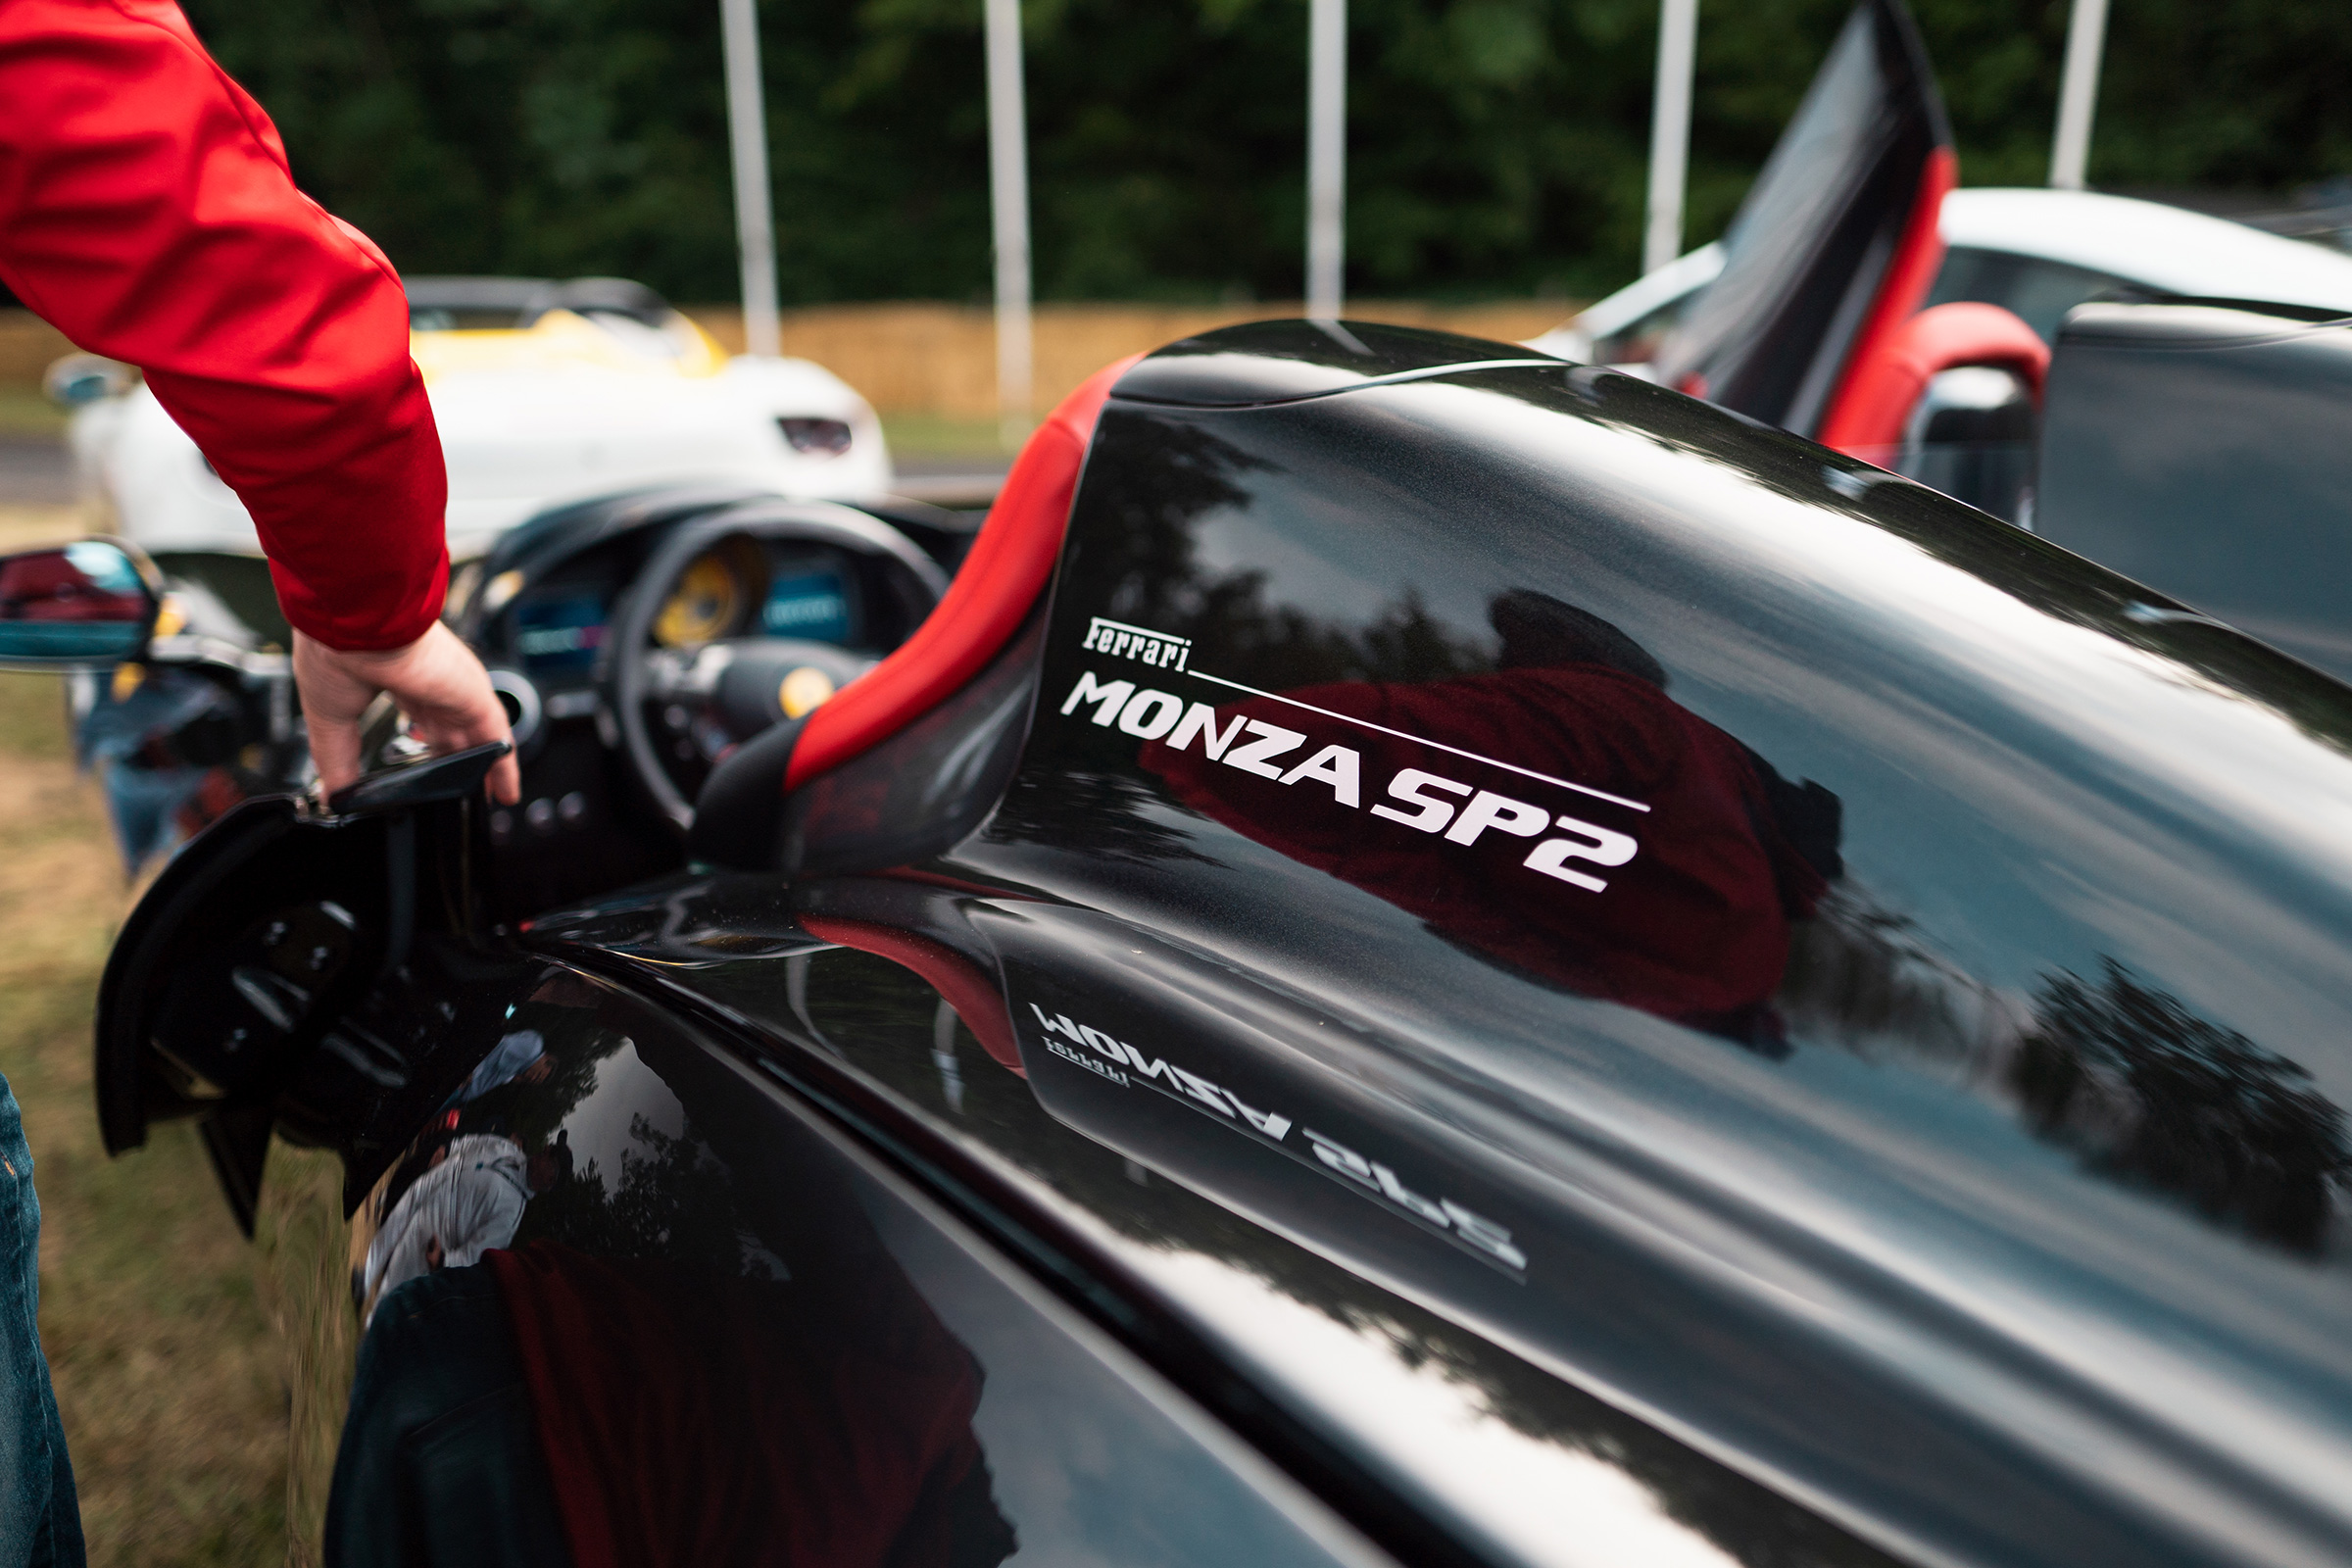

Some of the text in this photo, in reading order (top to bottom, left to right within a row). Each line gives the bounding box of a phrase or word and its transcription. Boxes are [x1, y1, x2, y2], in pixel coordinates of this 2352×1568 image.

[1082, 616, 1192, 672] Ferrari
[1060, 671, 1639, 893] MONZA SP2
